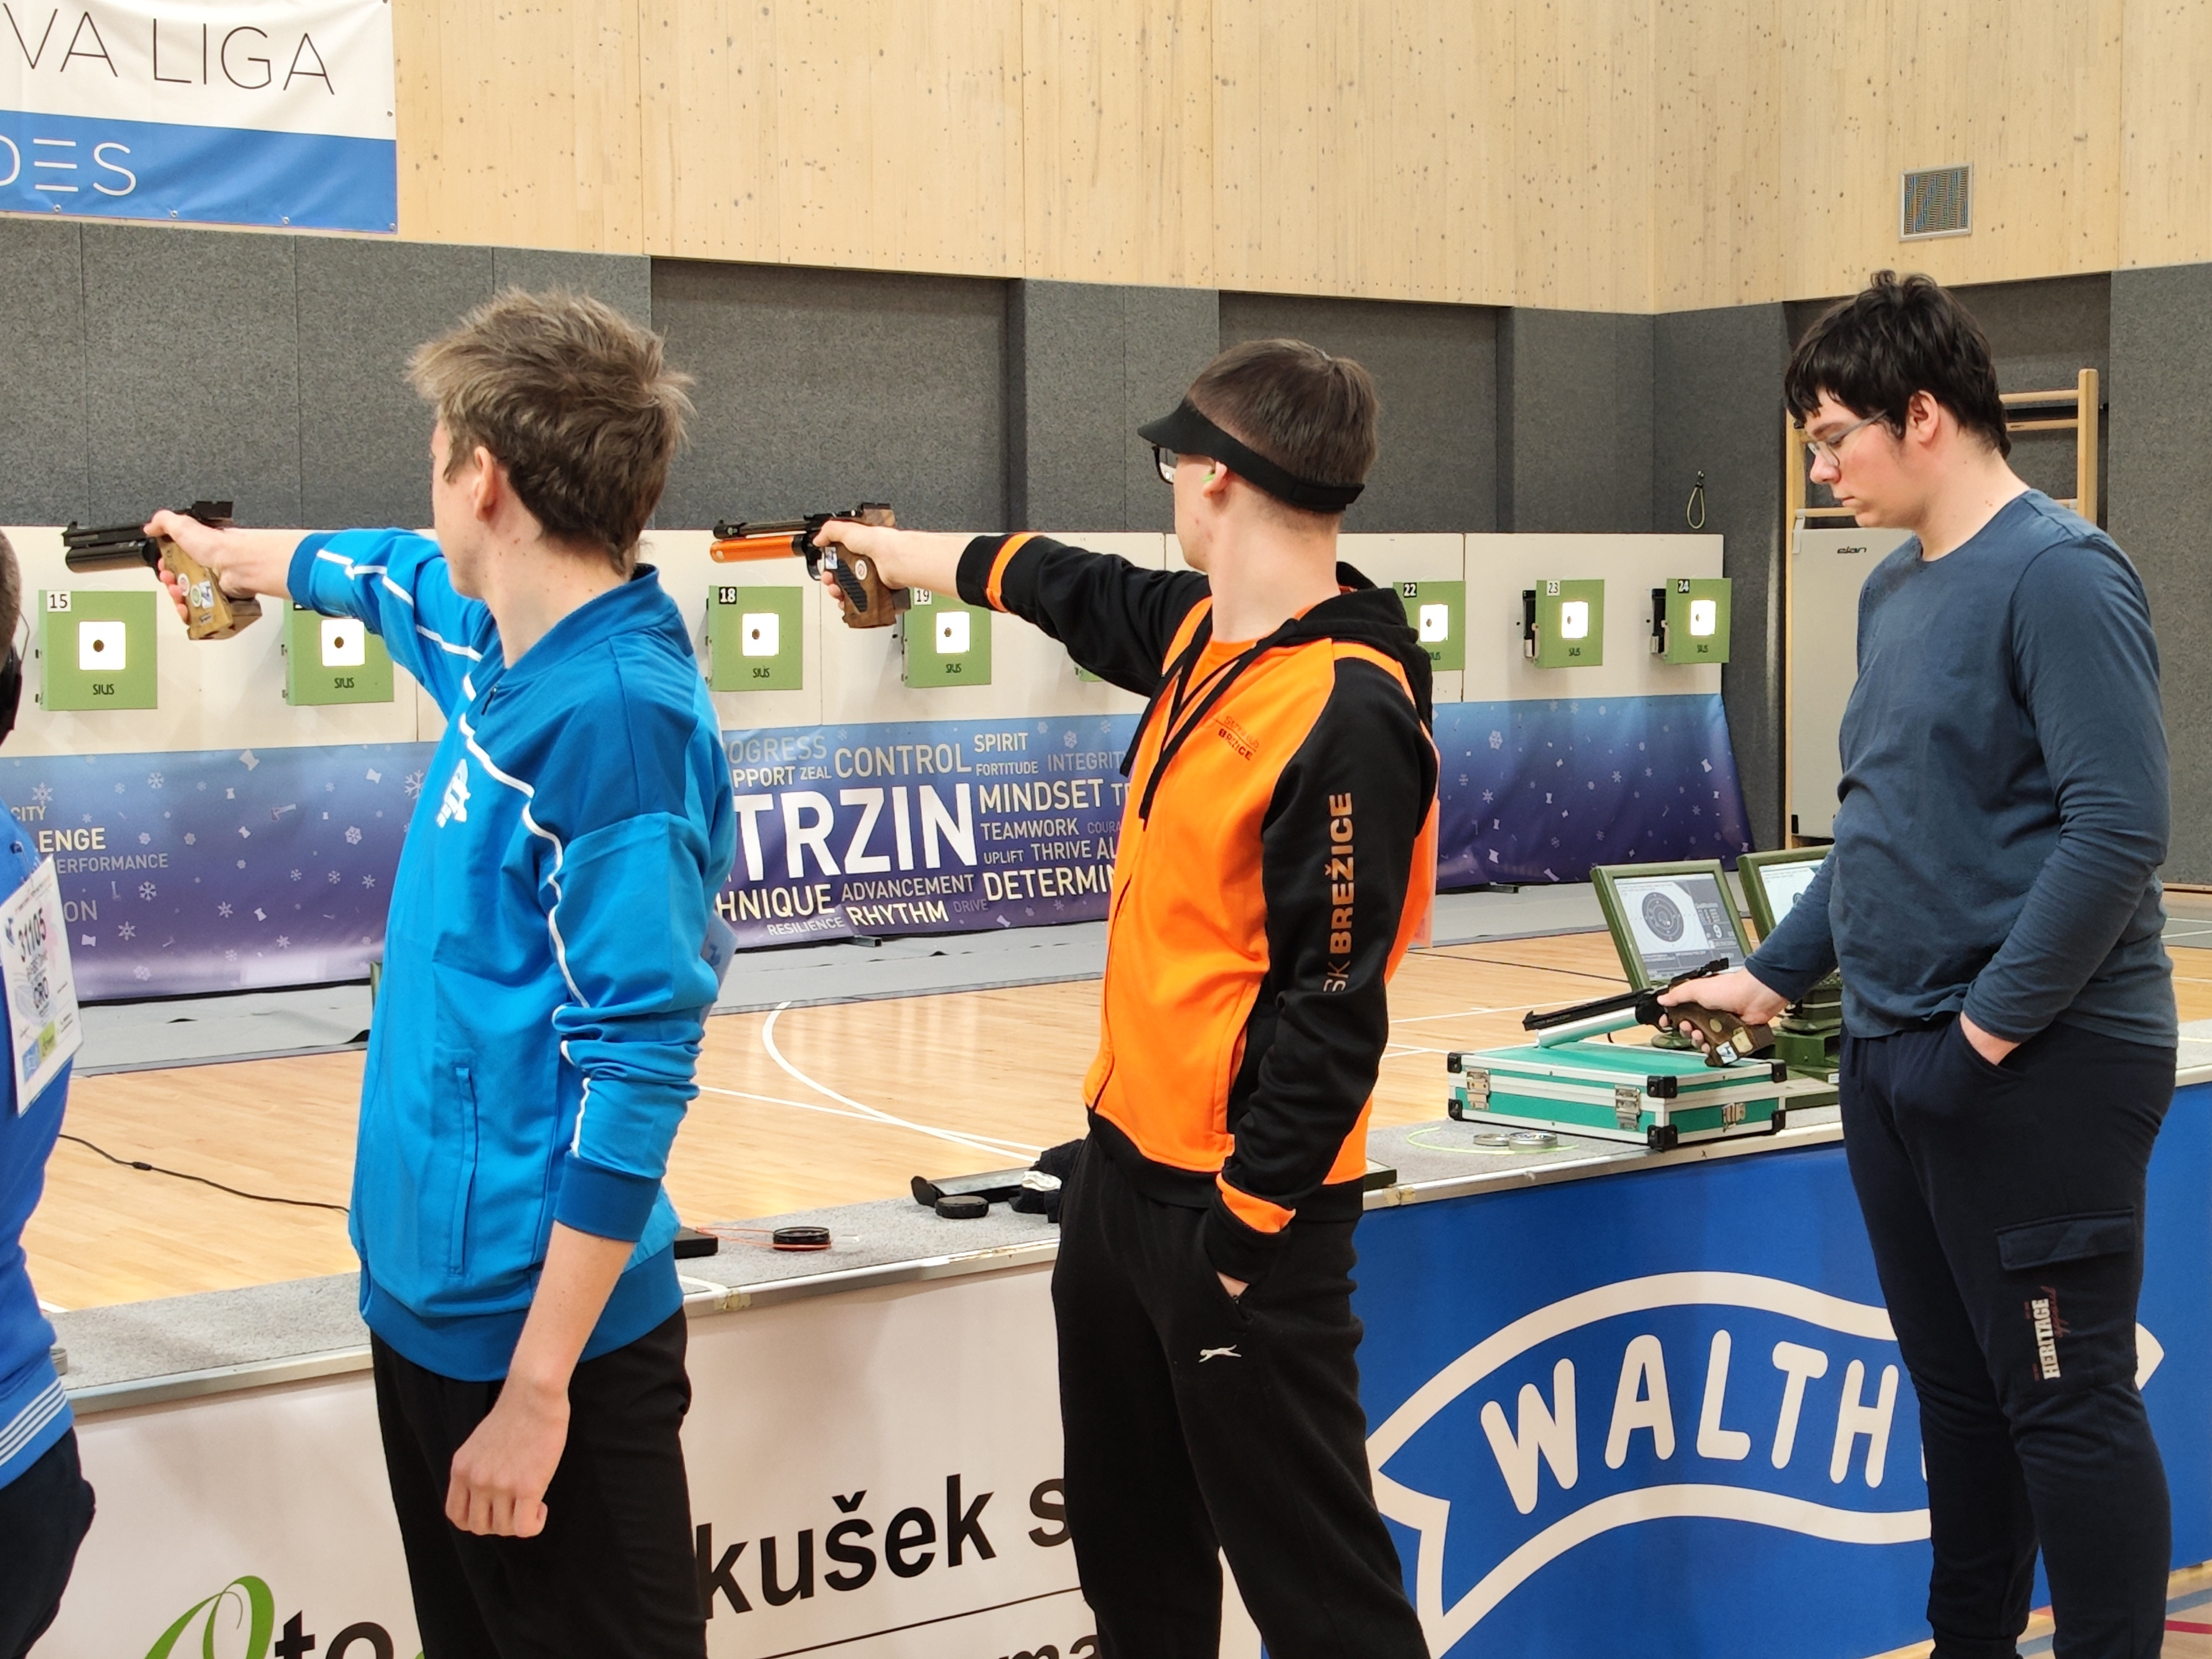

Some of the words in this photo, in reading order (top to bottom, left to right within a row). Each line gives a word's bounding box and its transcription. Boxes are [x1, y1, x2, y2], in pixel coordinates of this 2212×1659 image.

[2, 2, 118, 78] VA
[153, 18, 335, 95] LIGA
[720, 588, 736, 603] 18
[916, 589, 930, 603] 19
[1404, 583, 1417, 597] 22
[1548, 582, 1559, 594] 23
[1678, 580, 1689, 592] 24
[49, 593, 69, 610] 15
[92, 683, 114, 696] SIUS
[334, 677, 355, 689] SIUS
[725, 735, 828, 765] OGRESS
[974, 732, 1029, 753] SPIRIT
[834, 743, 972, 779] CONTROL
[975, 760, 1039, 777] FORTITUDE
[732, 765, 796, 788] PPORT
[799, 765, 833, 781] ZEAL
[979, 778, 1104, 814] MINDSET
[38, 827, 106, 853] ENGE
[980, 817, 1080, 841] TEAMWORK
[983, 849, 1024, 865] UPLIFT
[1030, 840, 1092, 862] THRIVE
[1325, 792, 1355, 954] BREŽICE
[841, 873, 975, 902] ADVANCEMENT
[63, 899, 98, 923] ON
[766, 916, 846, 936] RESILIENCE
[845, 900, 950, 927] RHYTHM
[953, 898, 989, 913] DRIVE
[18, 907, 47, 963] 31105
[2031, 1298, 2061, 1380] HERITAGE
[1480, 1329, 1927, 1515] WALTH
